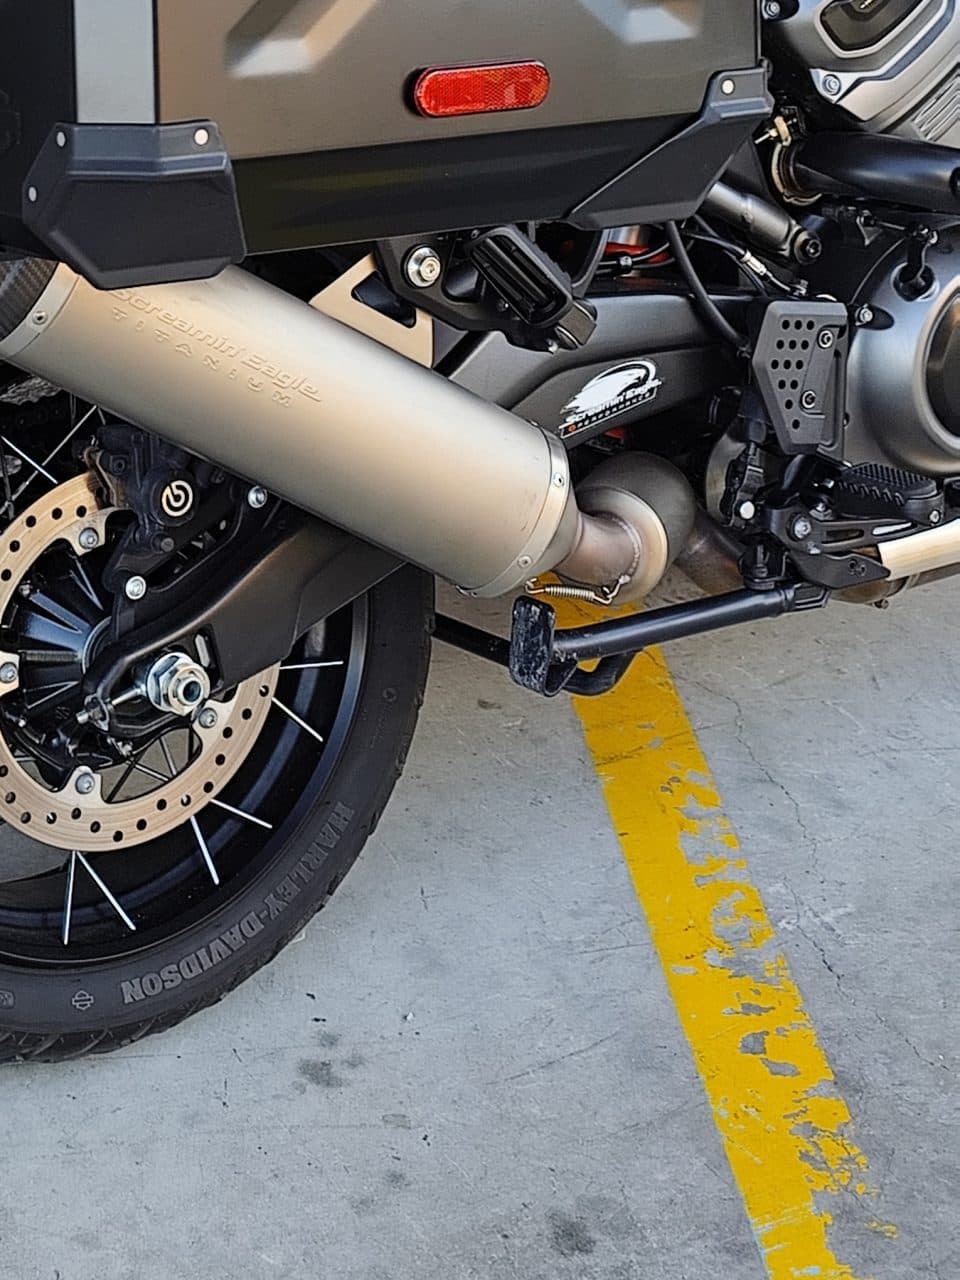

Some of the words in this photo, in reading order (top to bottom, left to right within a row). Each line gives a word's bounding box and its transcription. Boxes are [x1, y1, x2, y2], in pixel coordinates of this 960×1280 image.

[111, 307, 295, 409] TITANIUM
[239, 350, 322, 403] Eagle
[120, 800, 356, 1005] HARLEY-DAVIDSON
